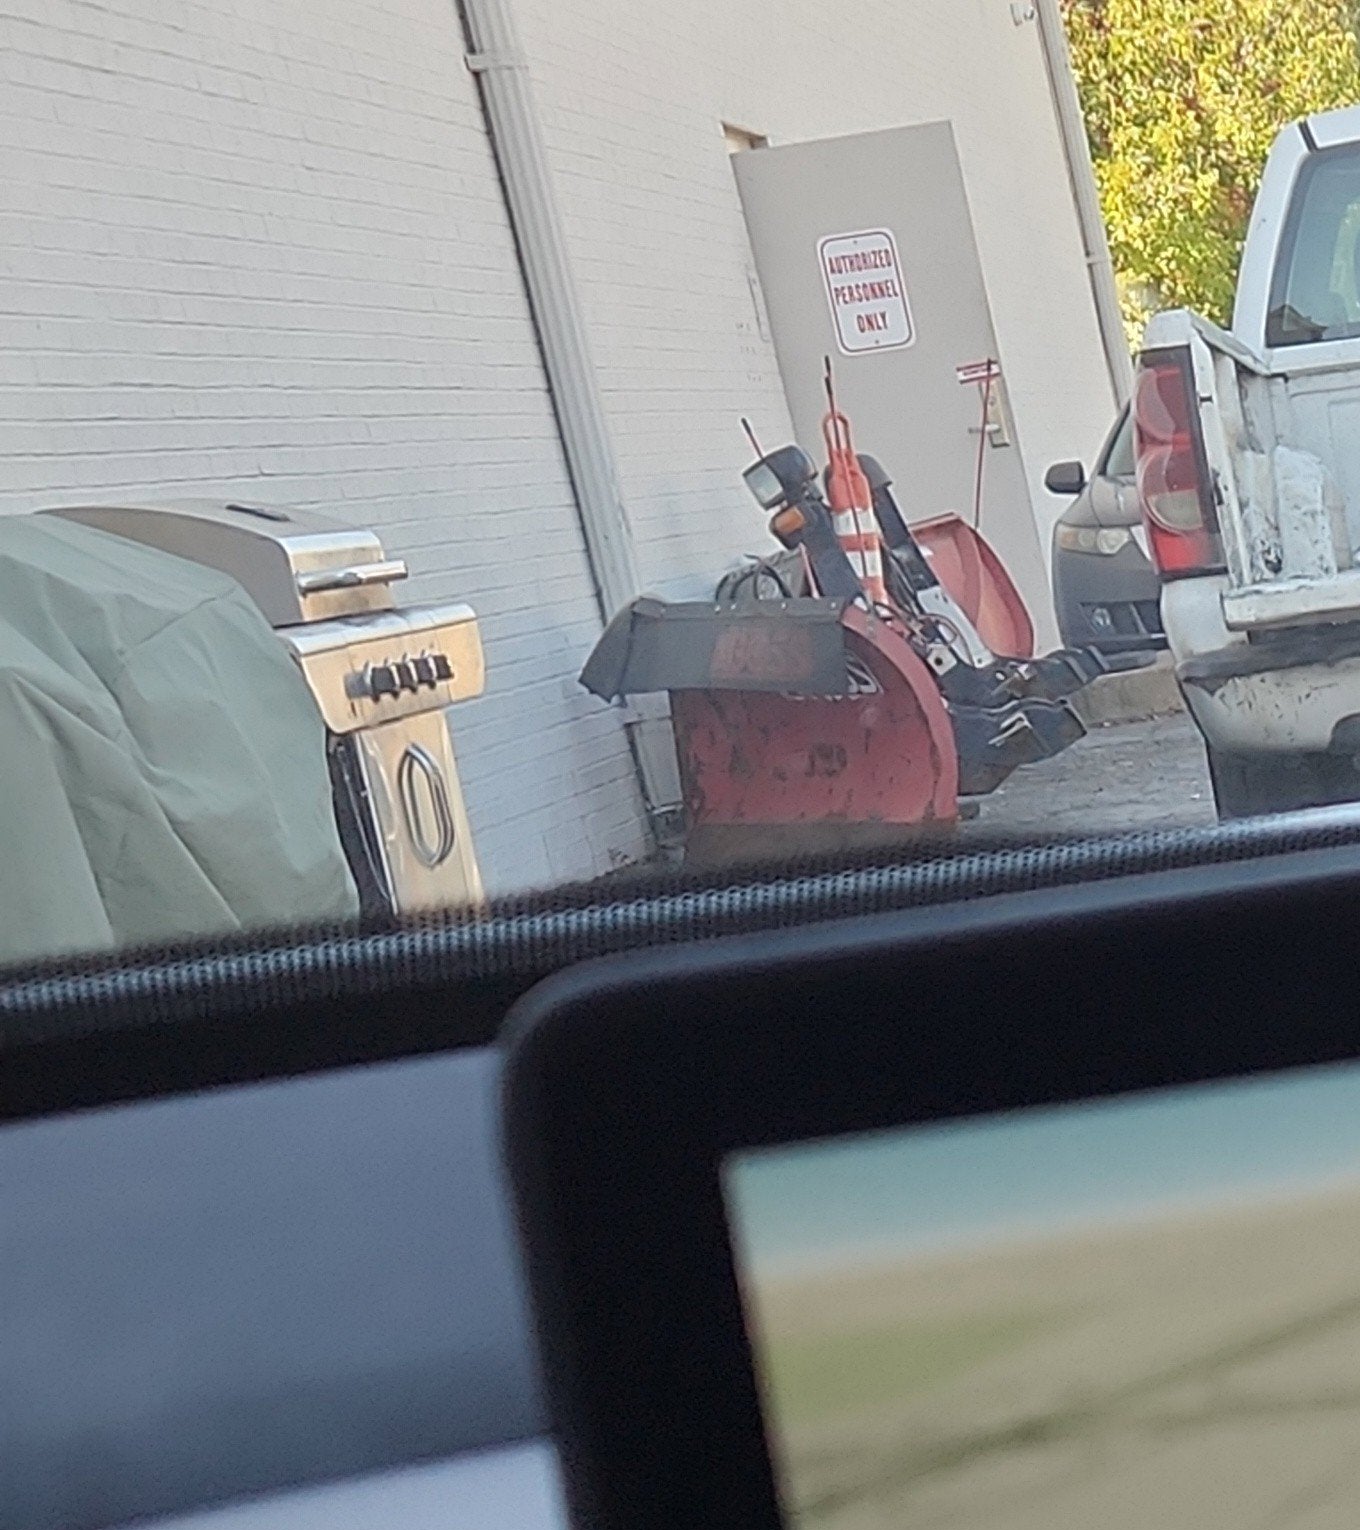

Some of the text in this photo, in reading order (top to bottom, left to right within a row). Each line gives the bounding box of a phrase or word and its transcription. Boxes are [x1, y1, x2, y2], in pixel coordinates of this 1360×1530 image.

[828, 248, 893, 275] AUTHORIZED
[833, 279, 899, 306] PERSONNEL
[856, 311, 889, 334] ONLY
